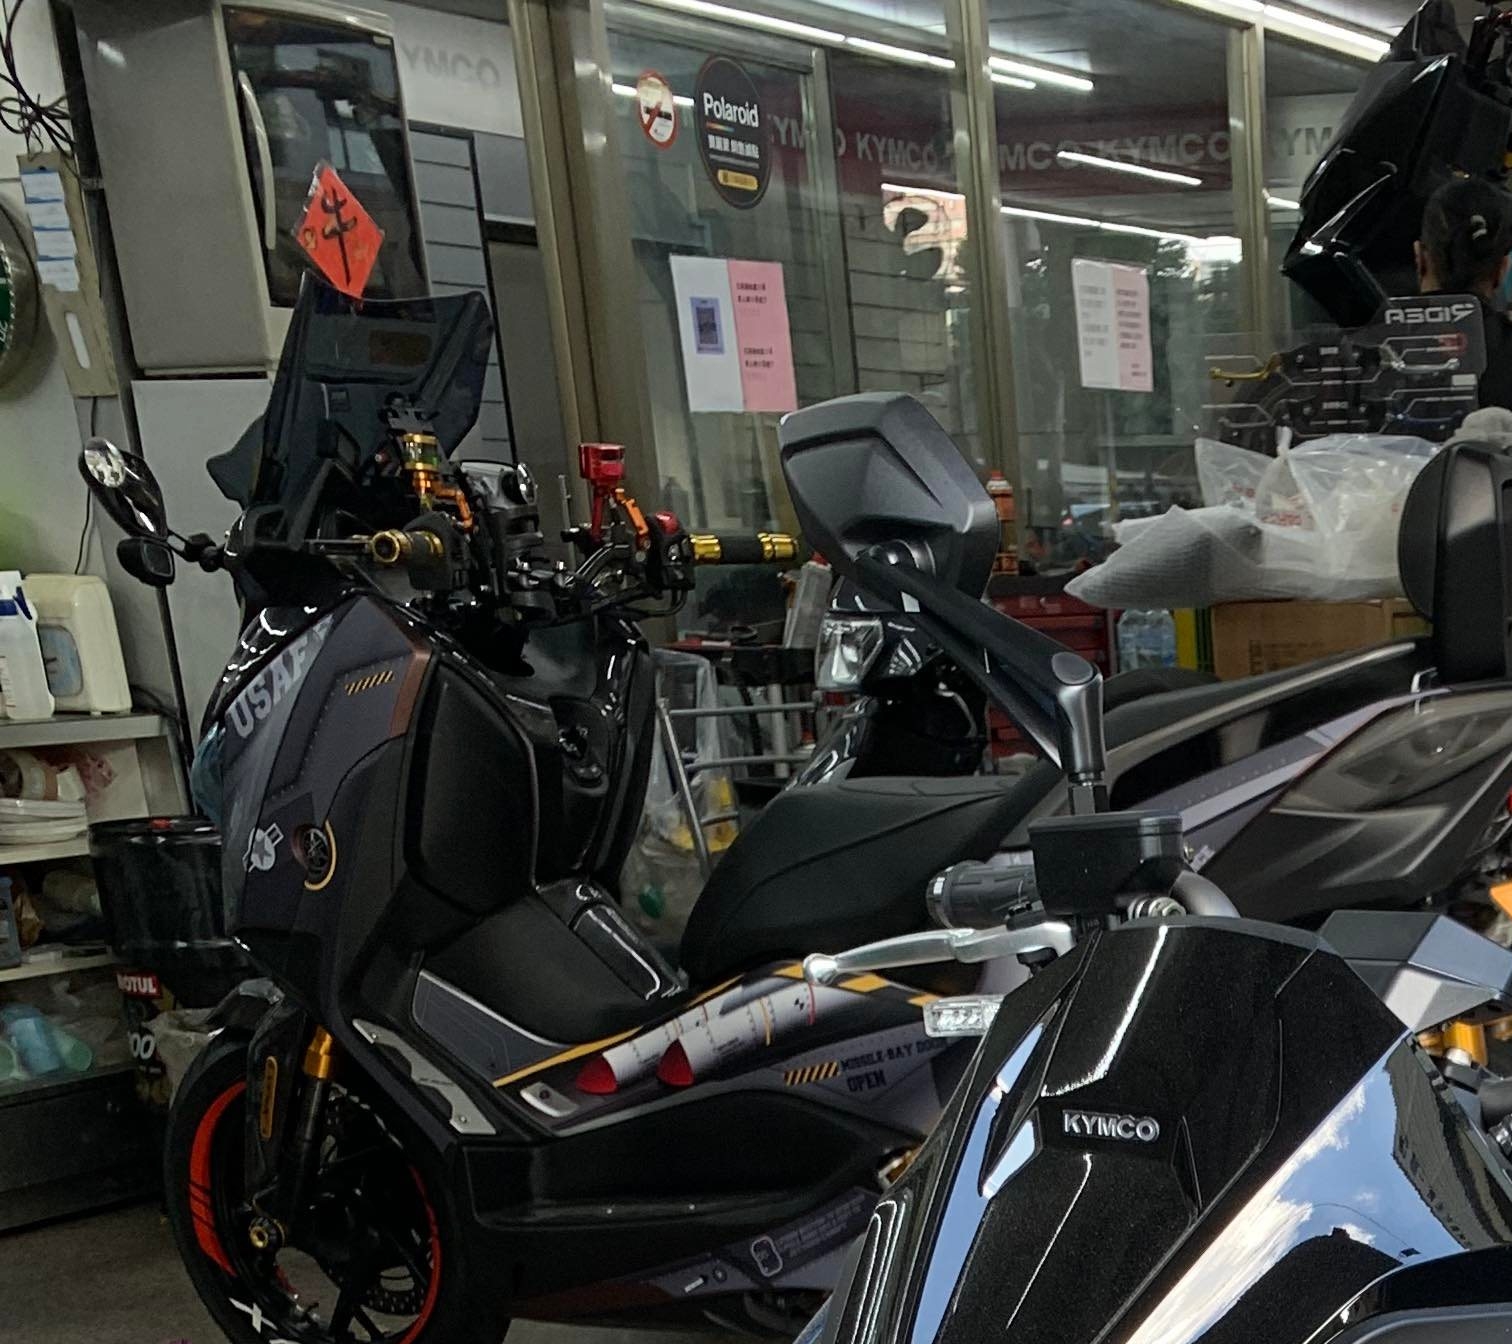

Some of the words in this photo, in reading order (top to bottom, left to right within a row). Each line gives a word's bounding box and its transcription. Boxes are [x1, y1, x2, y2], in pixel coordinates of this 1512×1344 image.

[703, 92, 760, 128] Polaroid
[846, 1069, 887, 1093] OPEN
[1062, 1109, 1160, 1143] KYMCO
